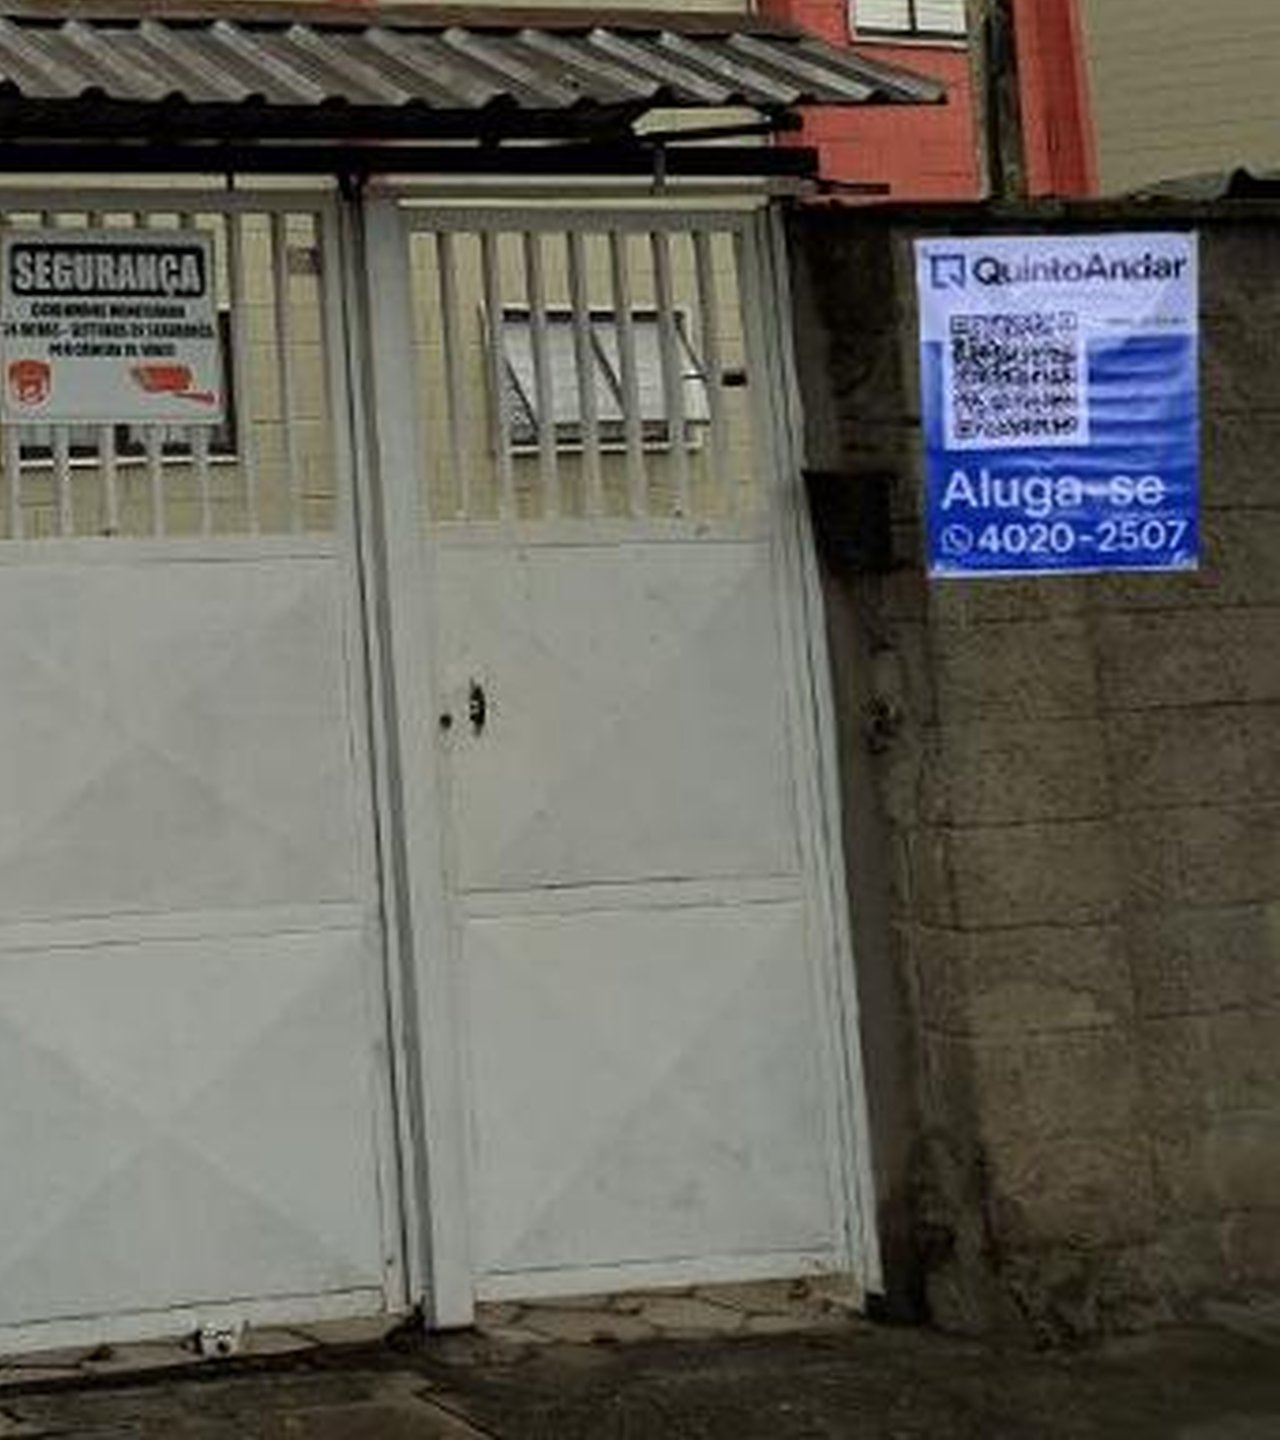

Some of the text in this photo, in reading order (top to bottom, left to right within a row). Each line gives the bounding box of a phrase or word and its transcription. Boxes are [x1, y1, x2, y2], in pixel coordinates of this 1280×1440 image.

[13, 249, 202, 297] SEGURANÇA
[971, 252, 1187, 286] QuintoAndar
[941, 468, 1168, 518] Aluga-se
[977, 519, 1189, 554] 4020-2507
